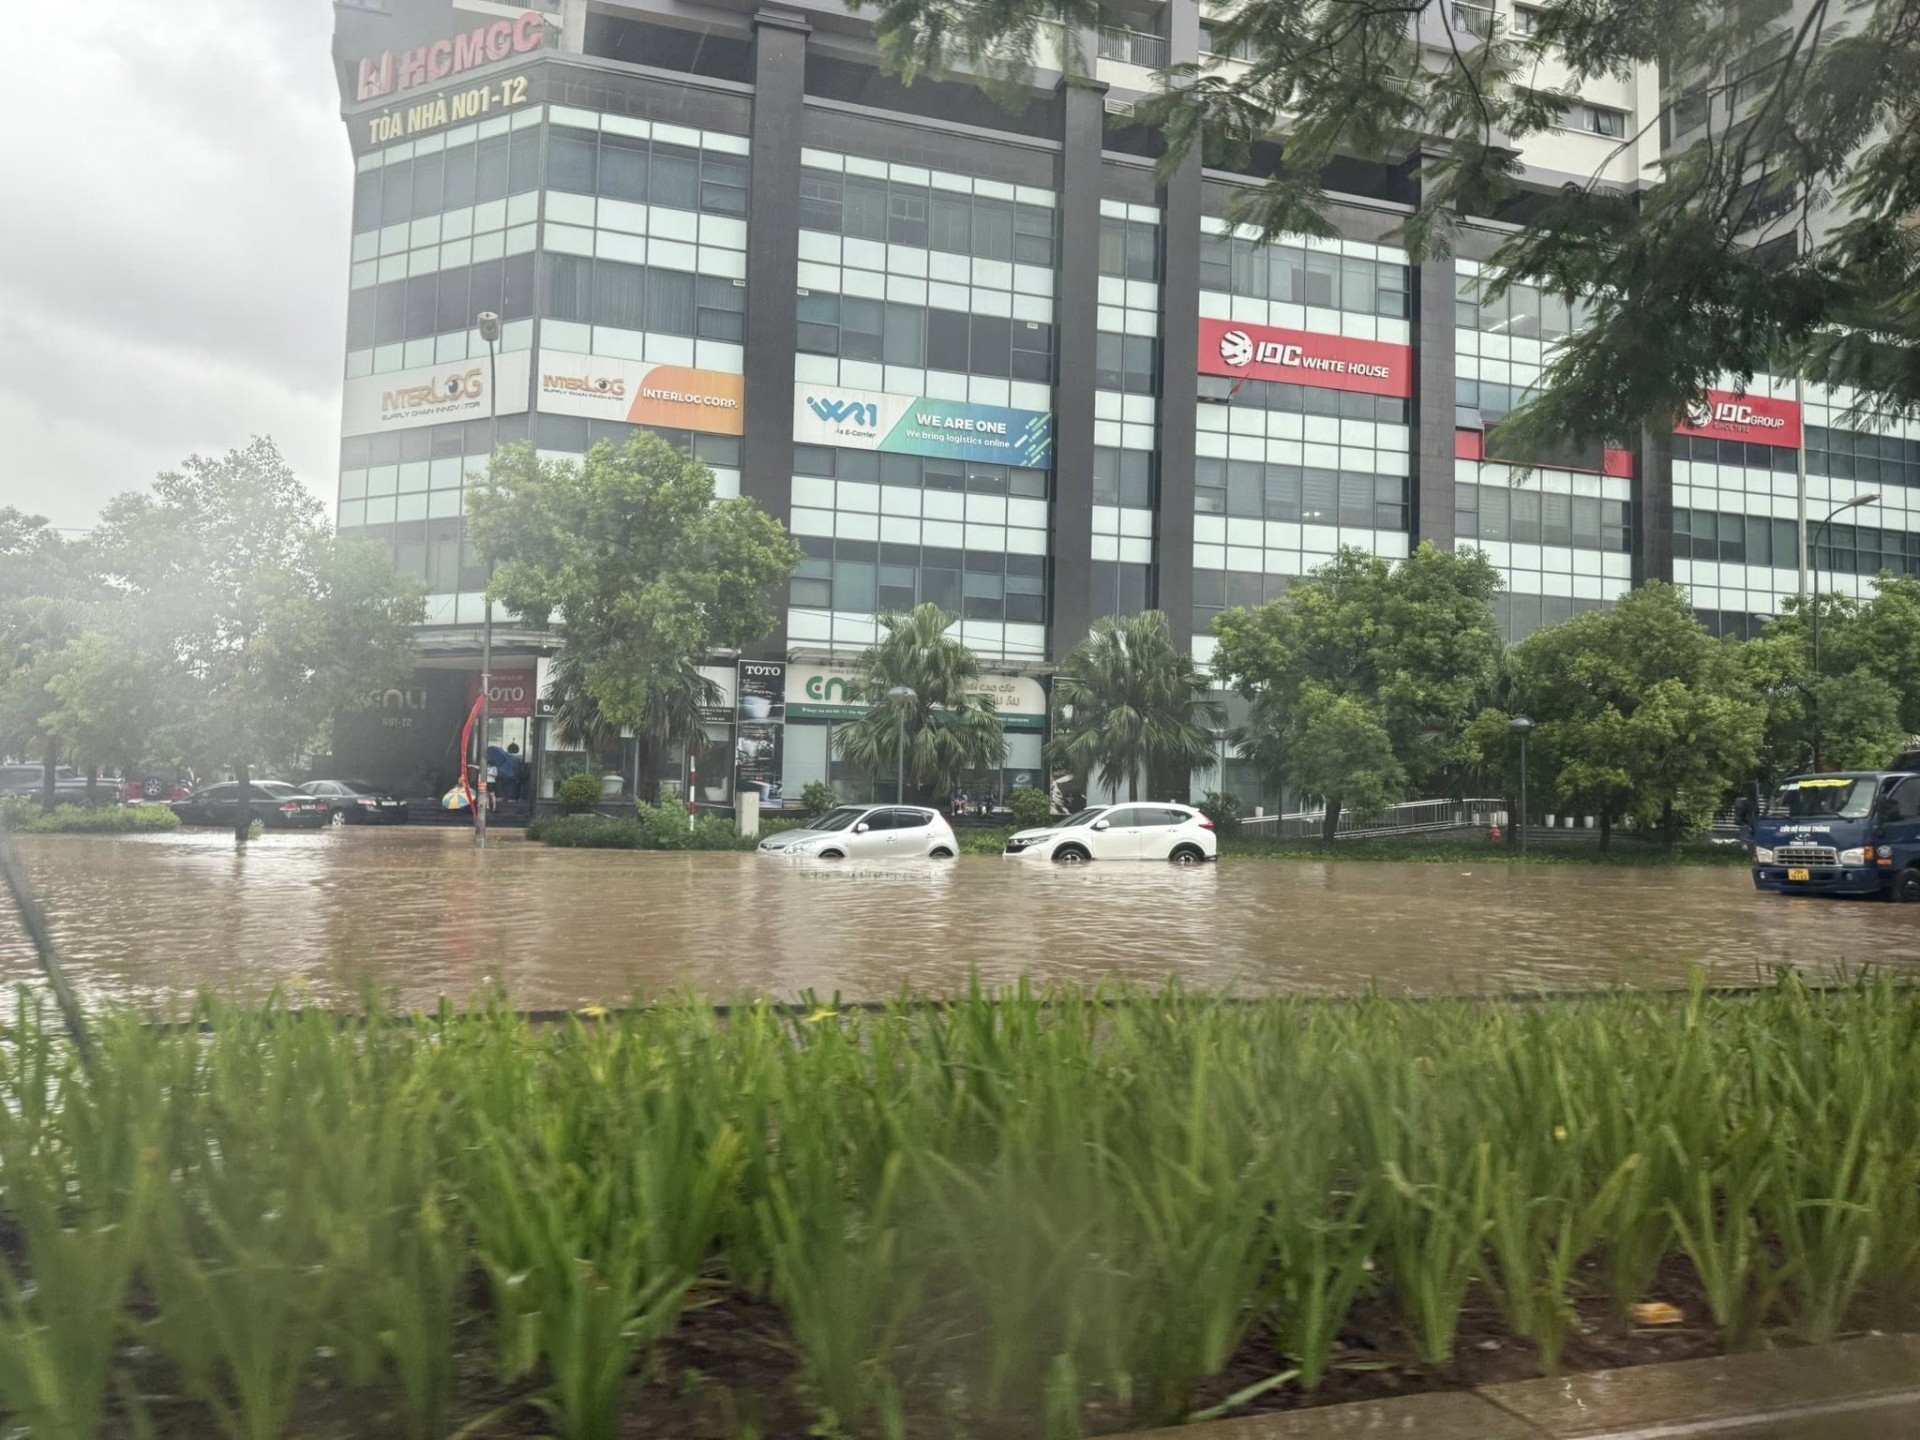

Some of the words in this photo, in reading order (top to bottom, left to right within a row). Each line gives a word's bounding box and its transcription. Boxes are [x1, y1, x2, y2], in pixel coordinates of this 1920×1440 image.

[369, 108, 405, 144] TÒA
[407, 93, 448, 133] NHÀ
[1255, 341, 1304, 366] IDC
[1302, 356, 1345, 373] WHITE
[1347, 362, 1389, 379] HOUSE
[435, 401, 481, 414] INNOVTOR
[643, 388, 702, 404] INTERLOG
[703, 396, 738, 409] CORP.
[916, 413, 942, 427] WE
[943, 416, 974, 431] ARE
[976, 420, 1007, 434] ONE
[1715, 402, 1752, 424] IDC
[1750, 415, 1785, 429] GROUP
[906, 429, 920, 438] We
[922, 431, 945, 442] bring
[946, 433, 982, 446] logistics
[984, 437, 1010, 448] online
[745, 665, 781, 676] TOTO
[489, 686, 525, 702] OTO
